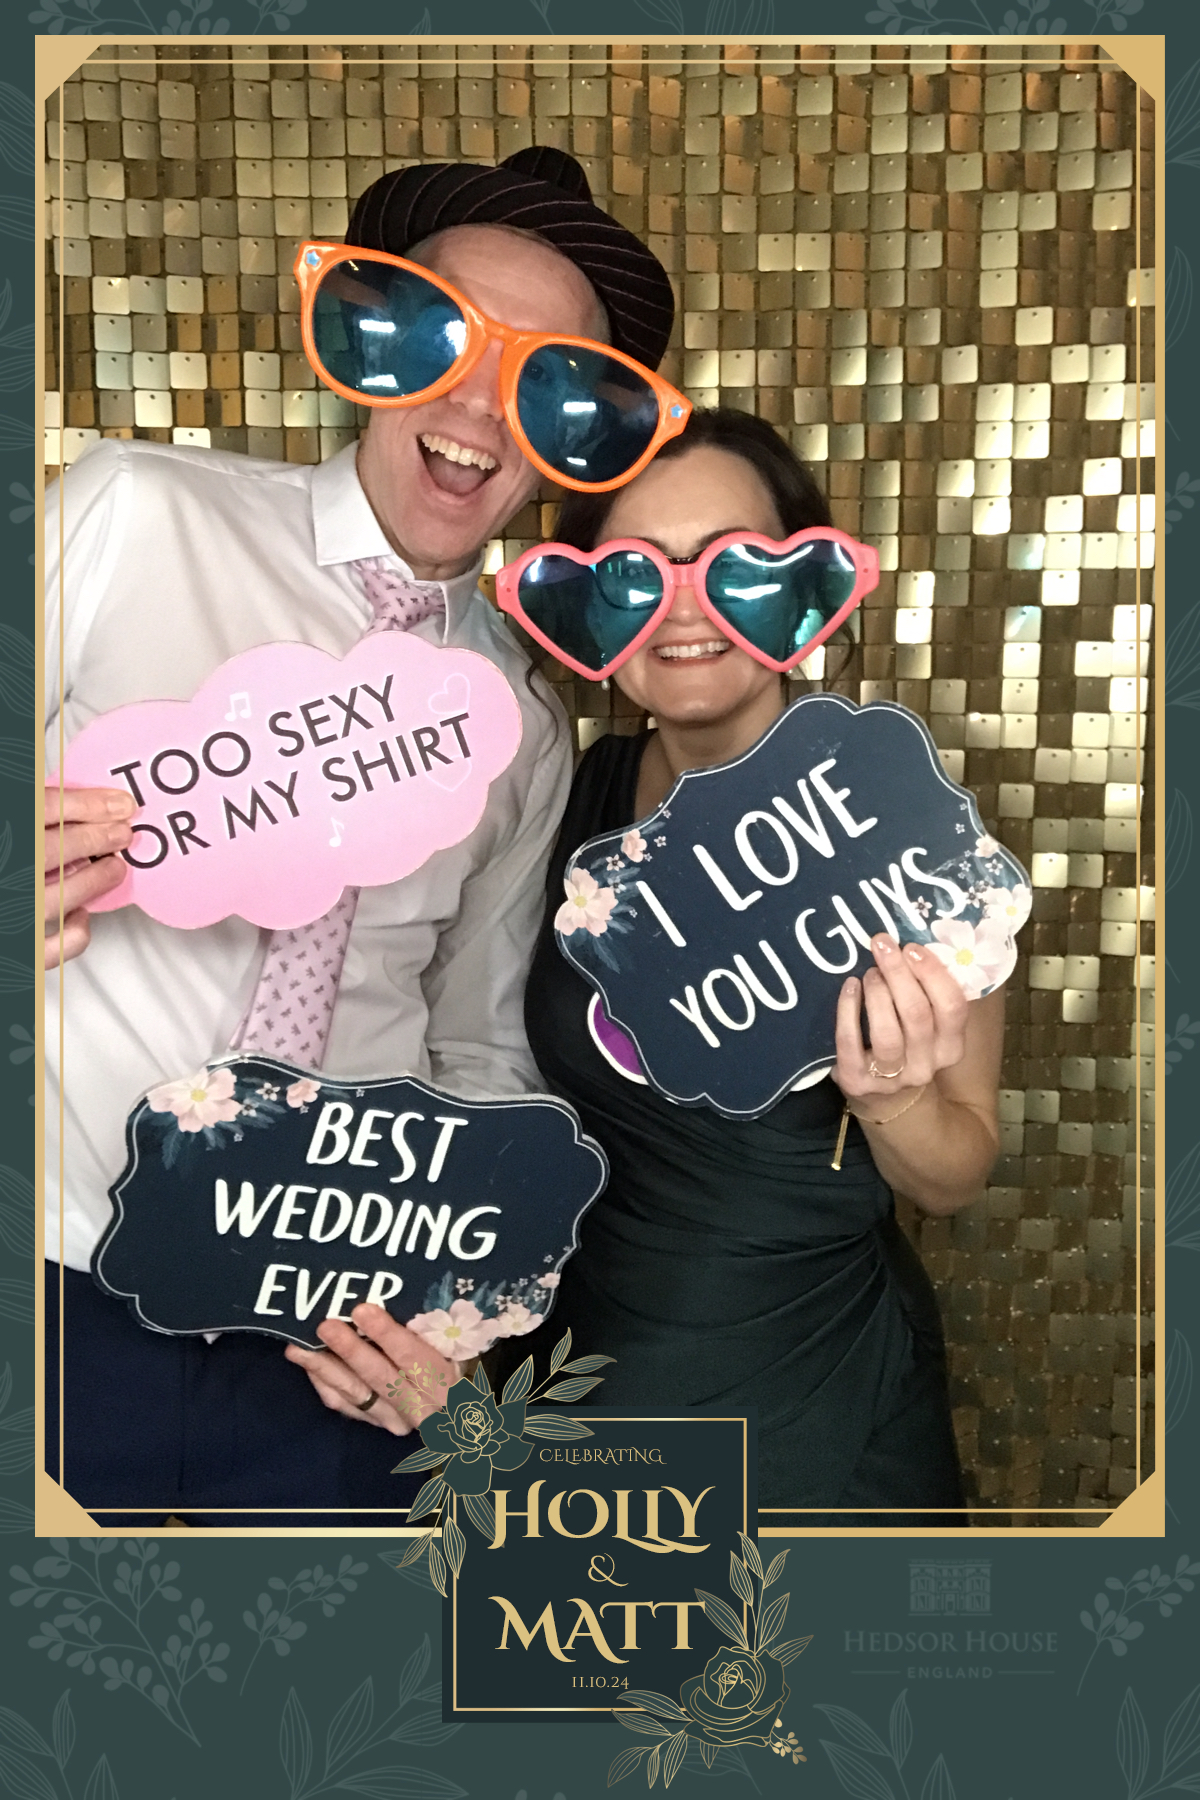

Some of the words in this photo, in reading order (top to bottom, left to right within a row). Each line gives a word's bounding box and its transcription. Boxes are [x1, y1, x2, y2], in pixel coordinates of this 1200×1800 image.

[88, 811, 212, 869] OR
[223, 771, 300, 839] MY
[322, 713, 472, 801] SHIRT
[110, 731, 251, 808] TOO
[268, 674, 395, 757] SEXY
[636, 880, 687, 948] I
[693, 758, 878, 911] LOVE
[669, 940, 799, 1048] YOU
[795, 847, 969, 974] GUYS
[306, 1101, 468, 1183] BEST
[215, 1178, 502, 1261] WEDDING
[254, 1263, 403, 1334] EVER
